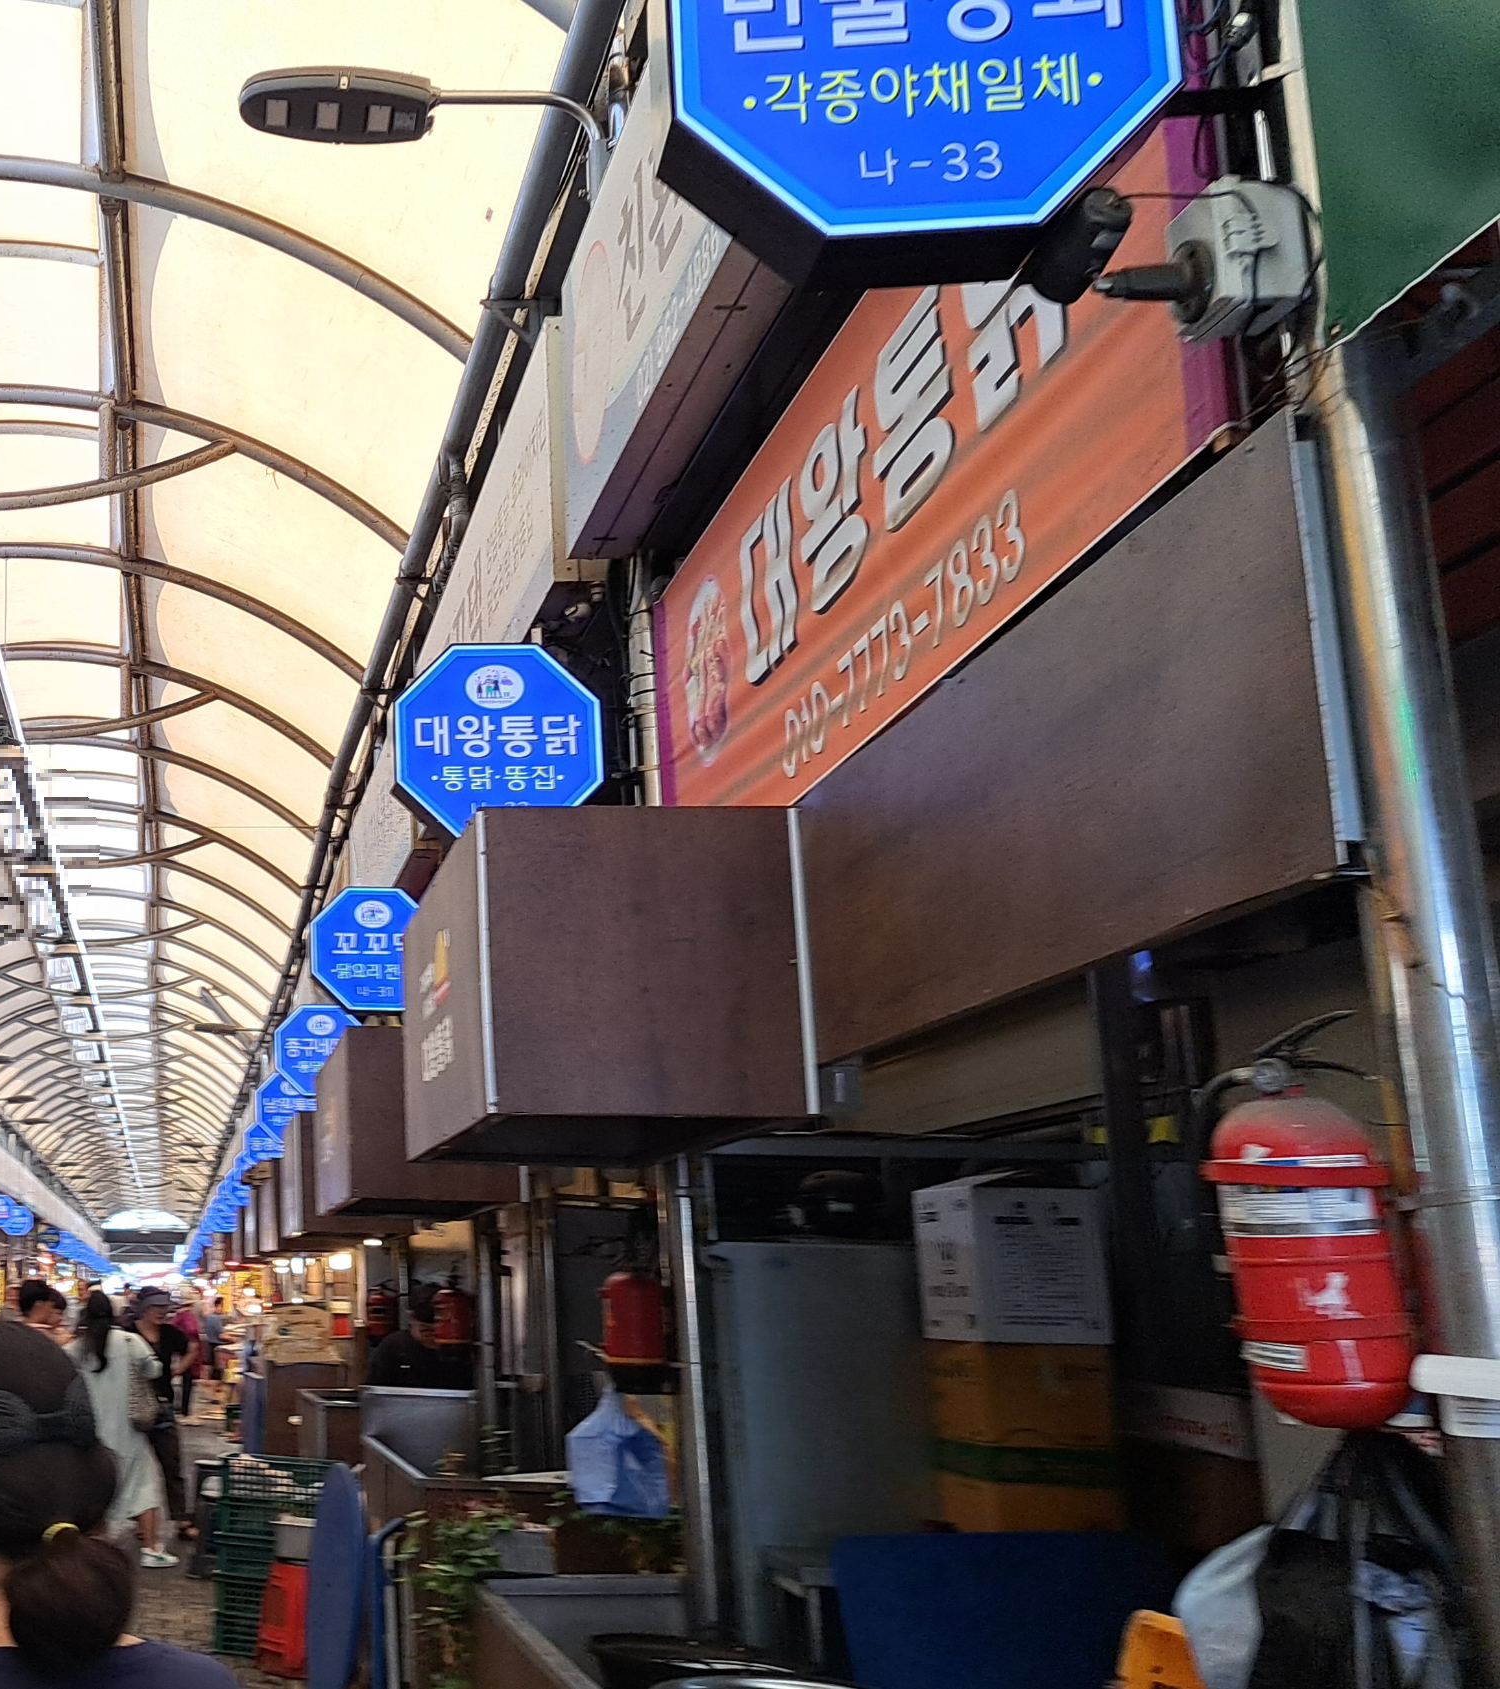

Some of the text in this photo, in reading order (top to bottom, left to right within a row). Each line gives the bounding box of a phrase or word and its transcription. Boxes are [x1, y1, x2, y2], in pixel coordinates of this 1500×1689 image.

[859, 140, 1004, 186] 나-33
[782, 488, 1026, 778] 010-7773-7833
[414, 713, 583, 758] 대왕통닭
